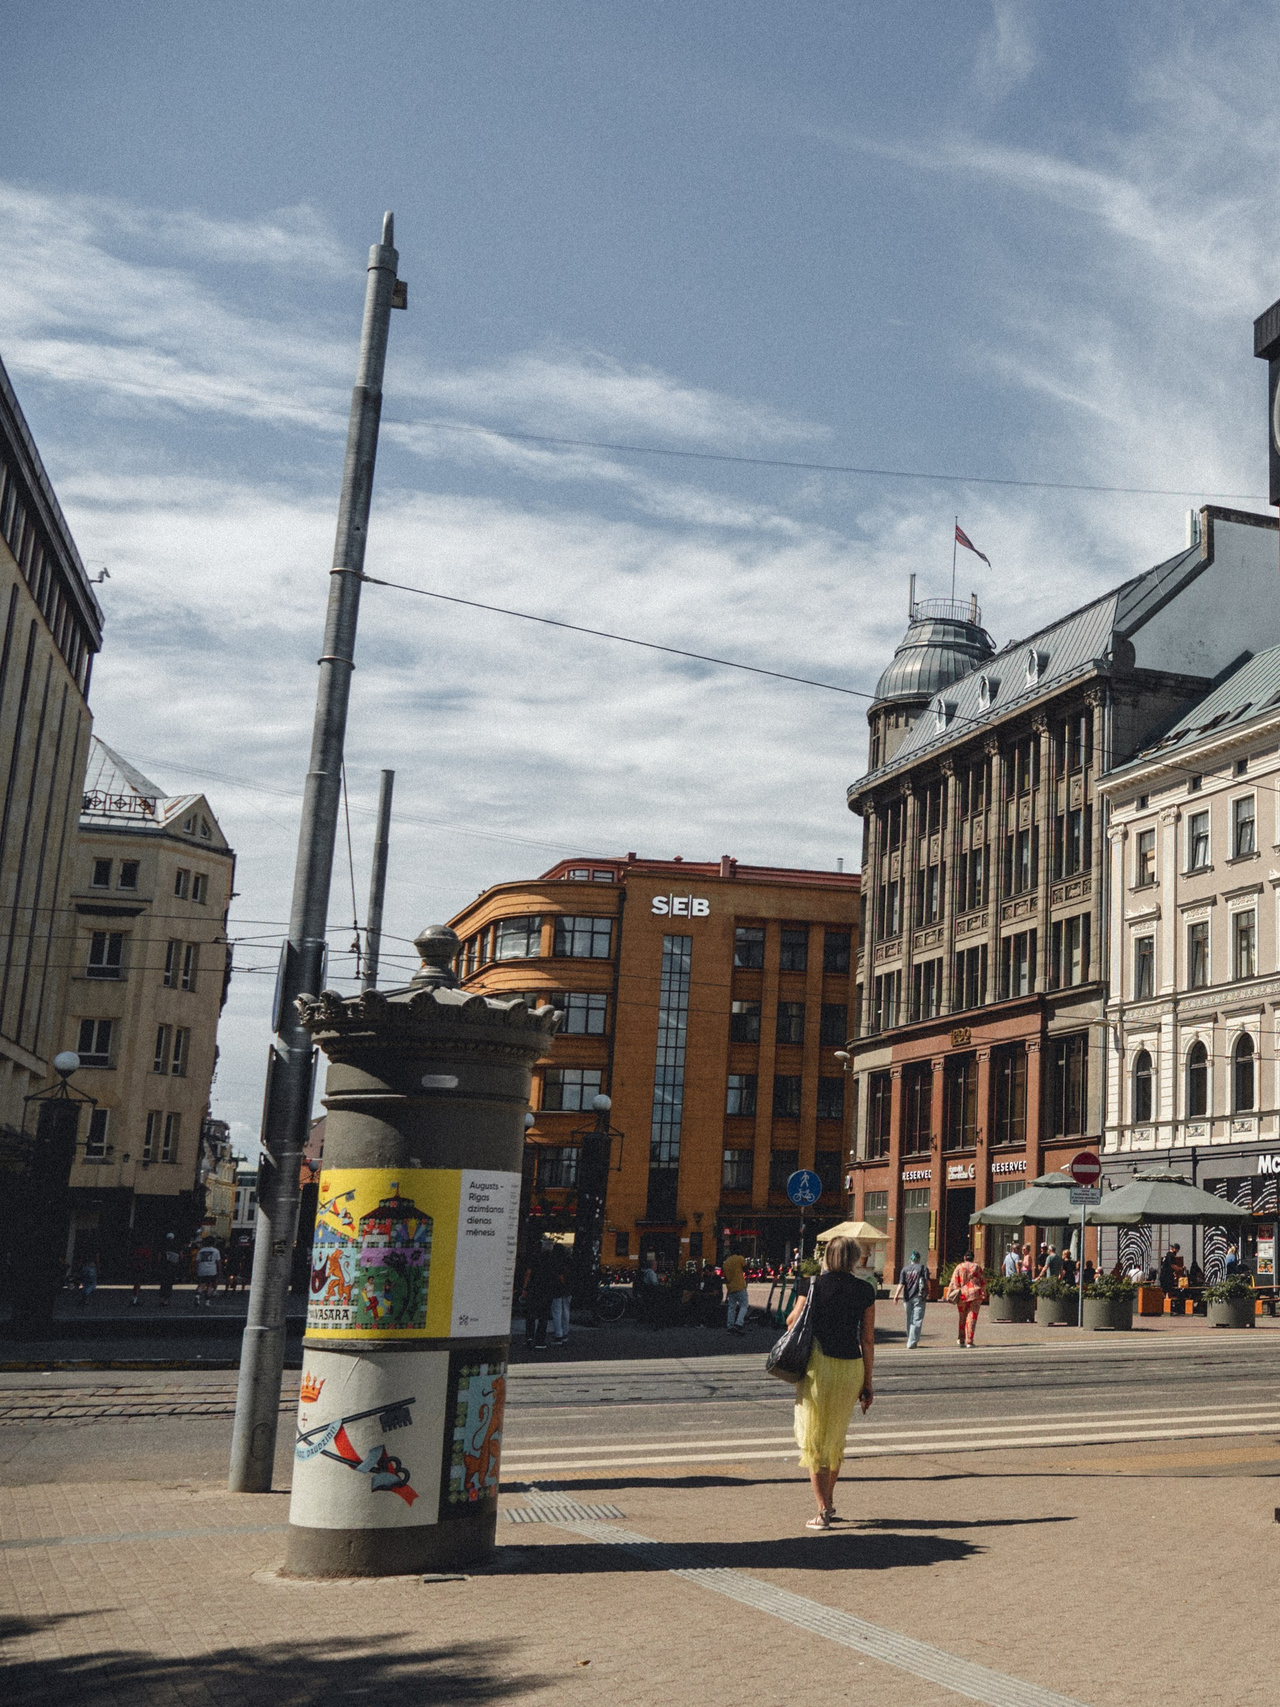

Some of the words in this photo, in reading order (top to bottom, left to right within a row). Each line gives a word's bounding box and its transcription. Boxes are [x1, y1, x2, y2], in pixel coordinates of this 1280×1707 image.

[651, 895, 710, 917] SEB
[469, 1181, 499, 1191] Augusts
[466, 1216, 492, 1225] dienas
